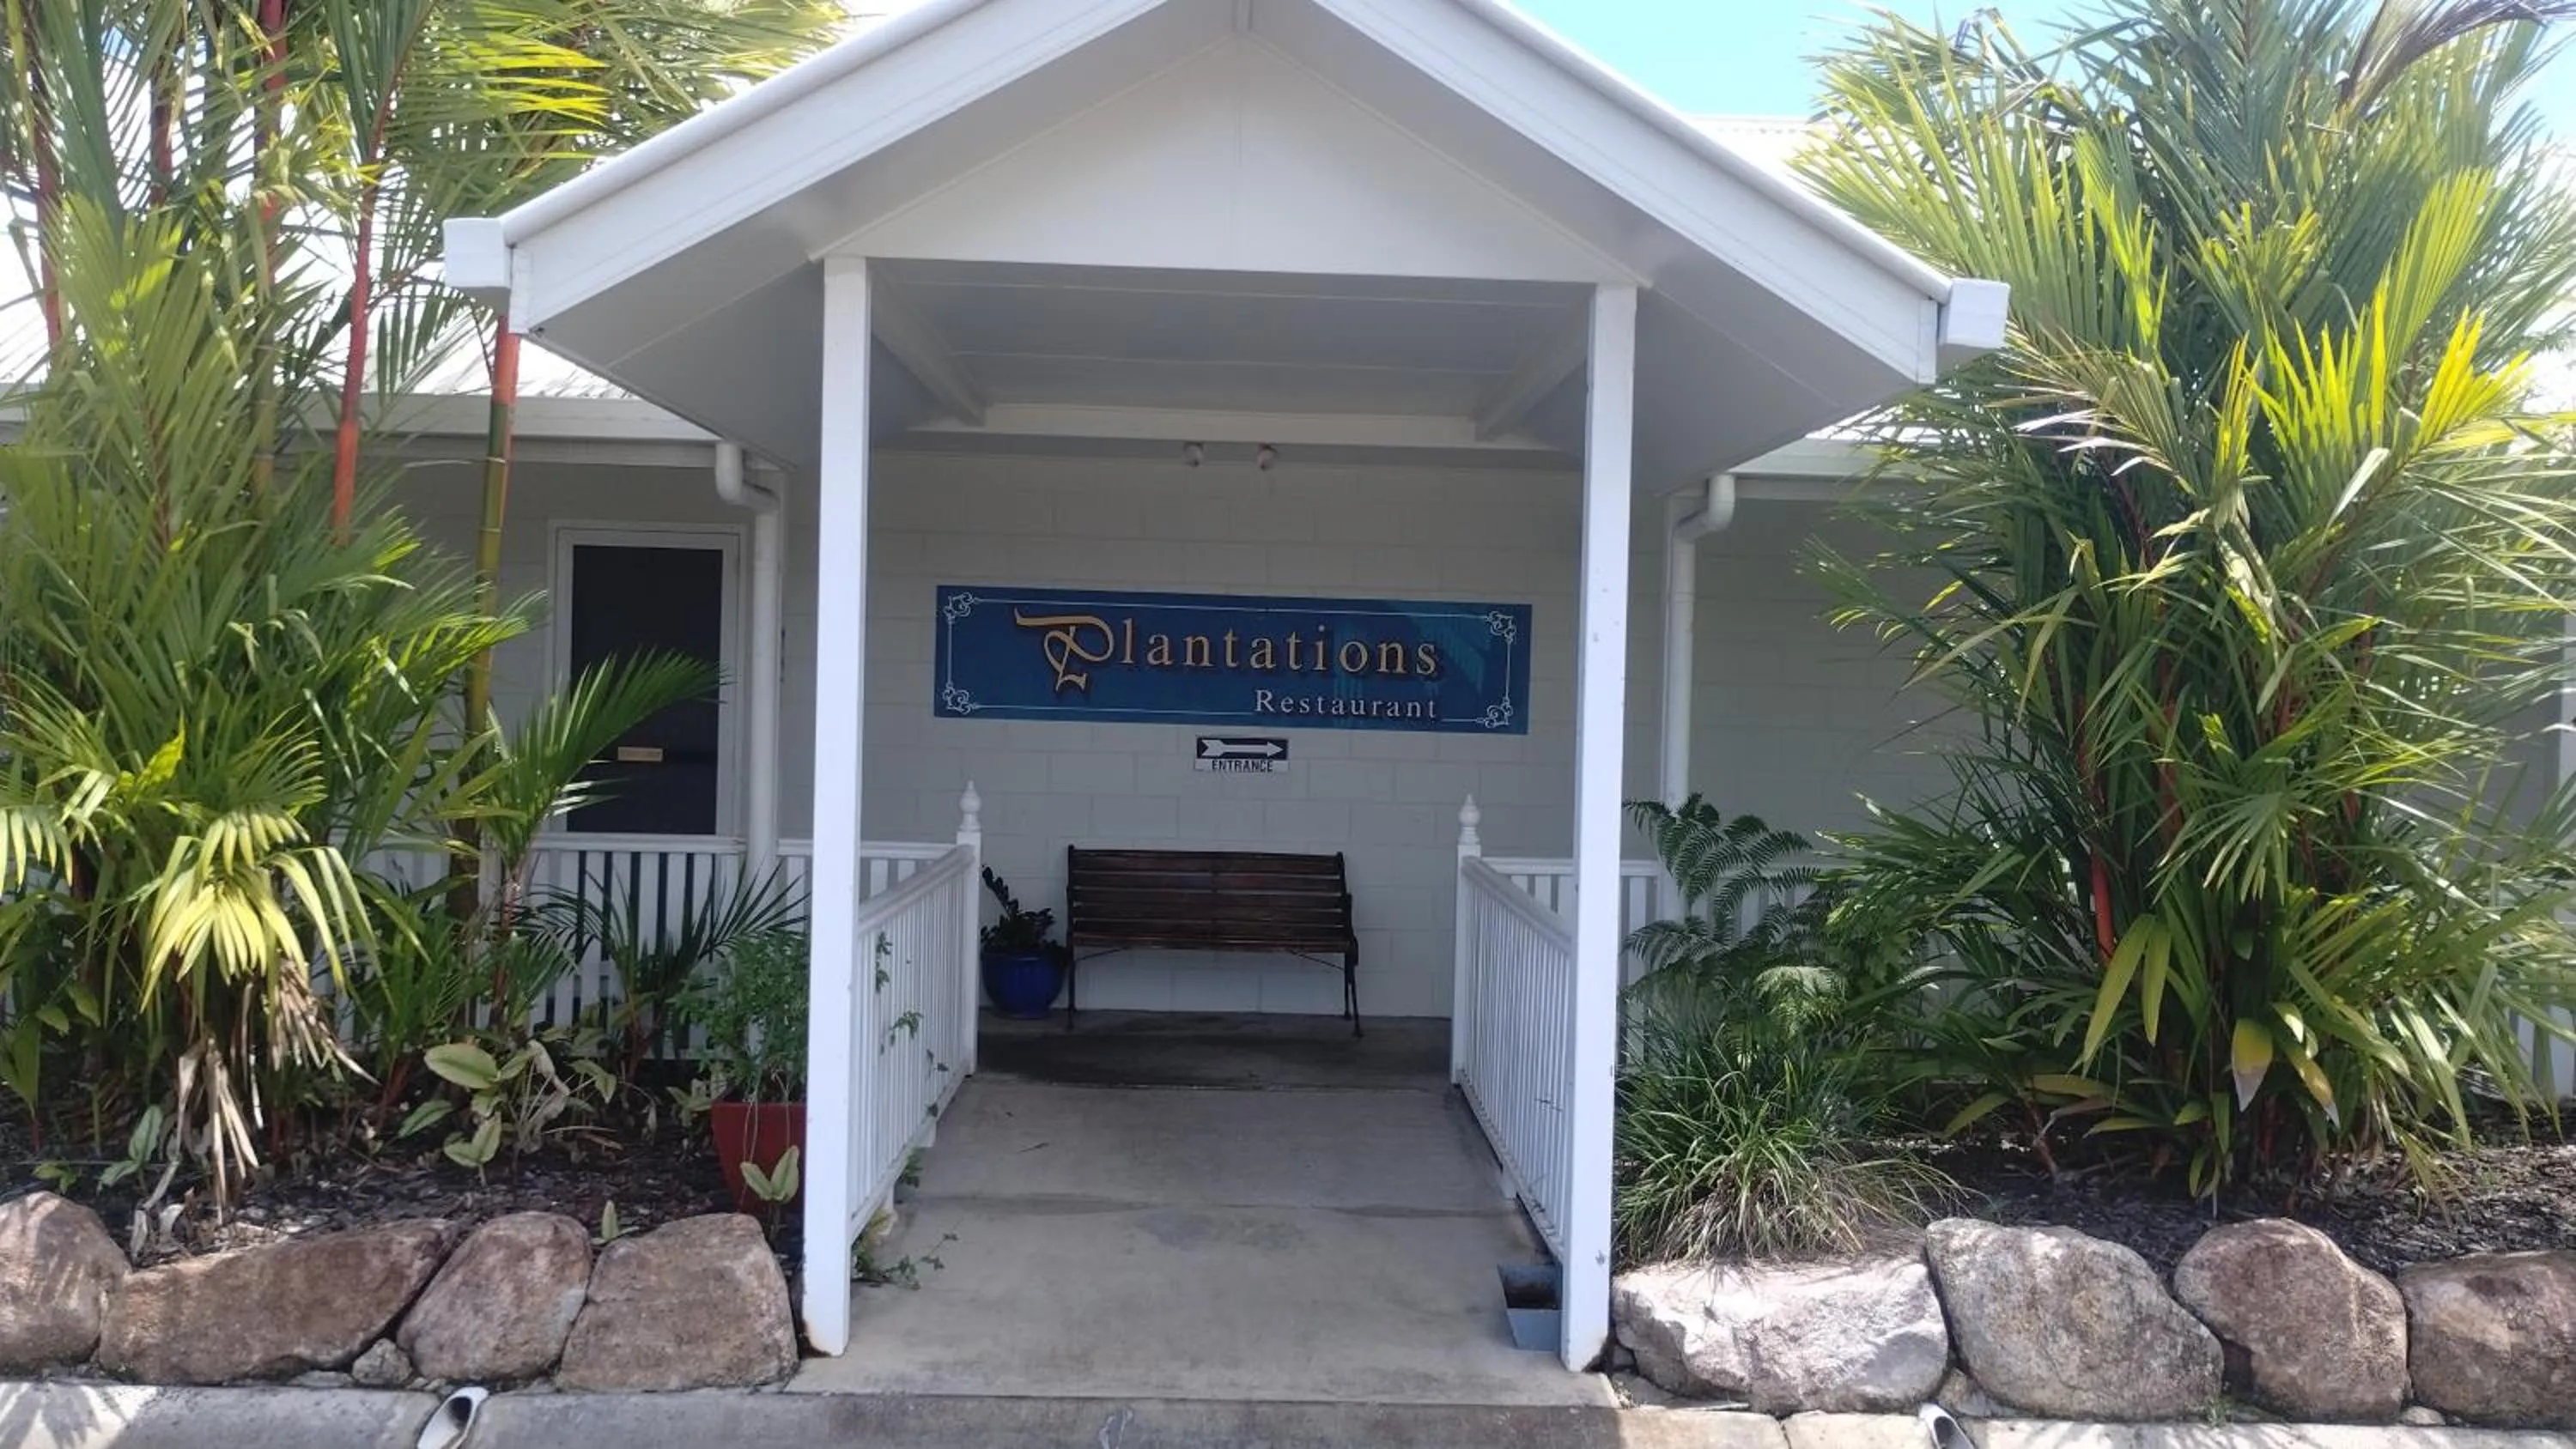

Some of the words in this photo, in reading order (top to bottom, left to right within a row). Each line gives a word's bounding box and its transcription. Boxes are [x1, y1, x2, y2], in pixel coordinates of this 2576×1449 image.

[1014, 607, 1439, 691] Plantations
[1255, 688, 1437, 718] Restaurant
[1212, 759, 1273, 773] ENTRANCE
